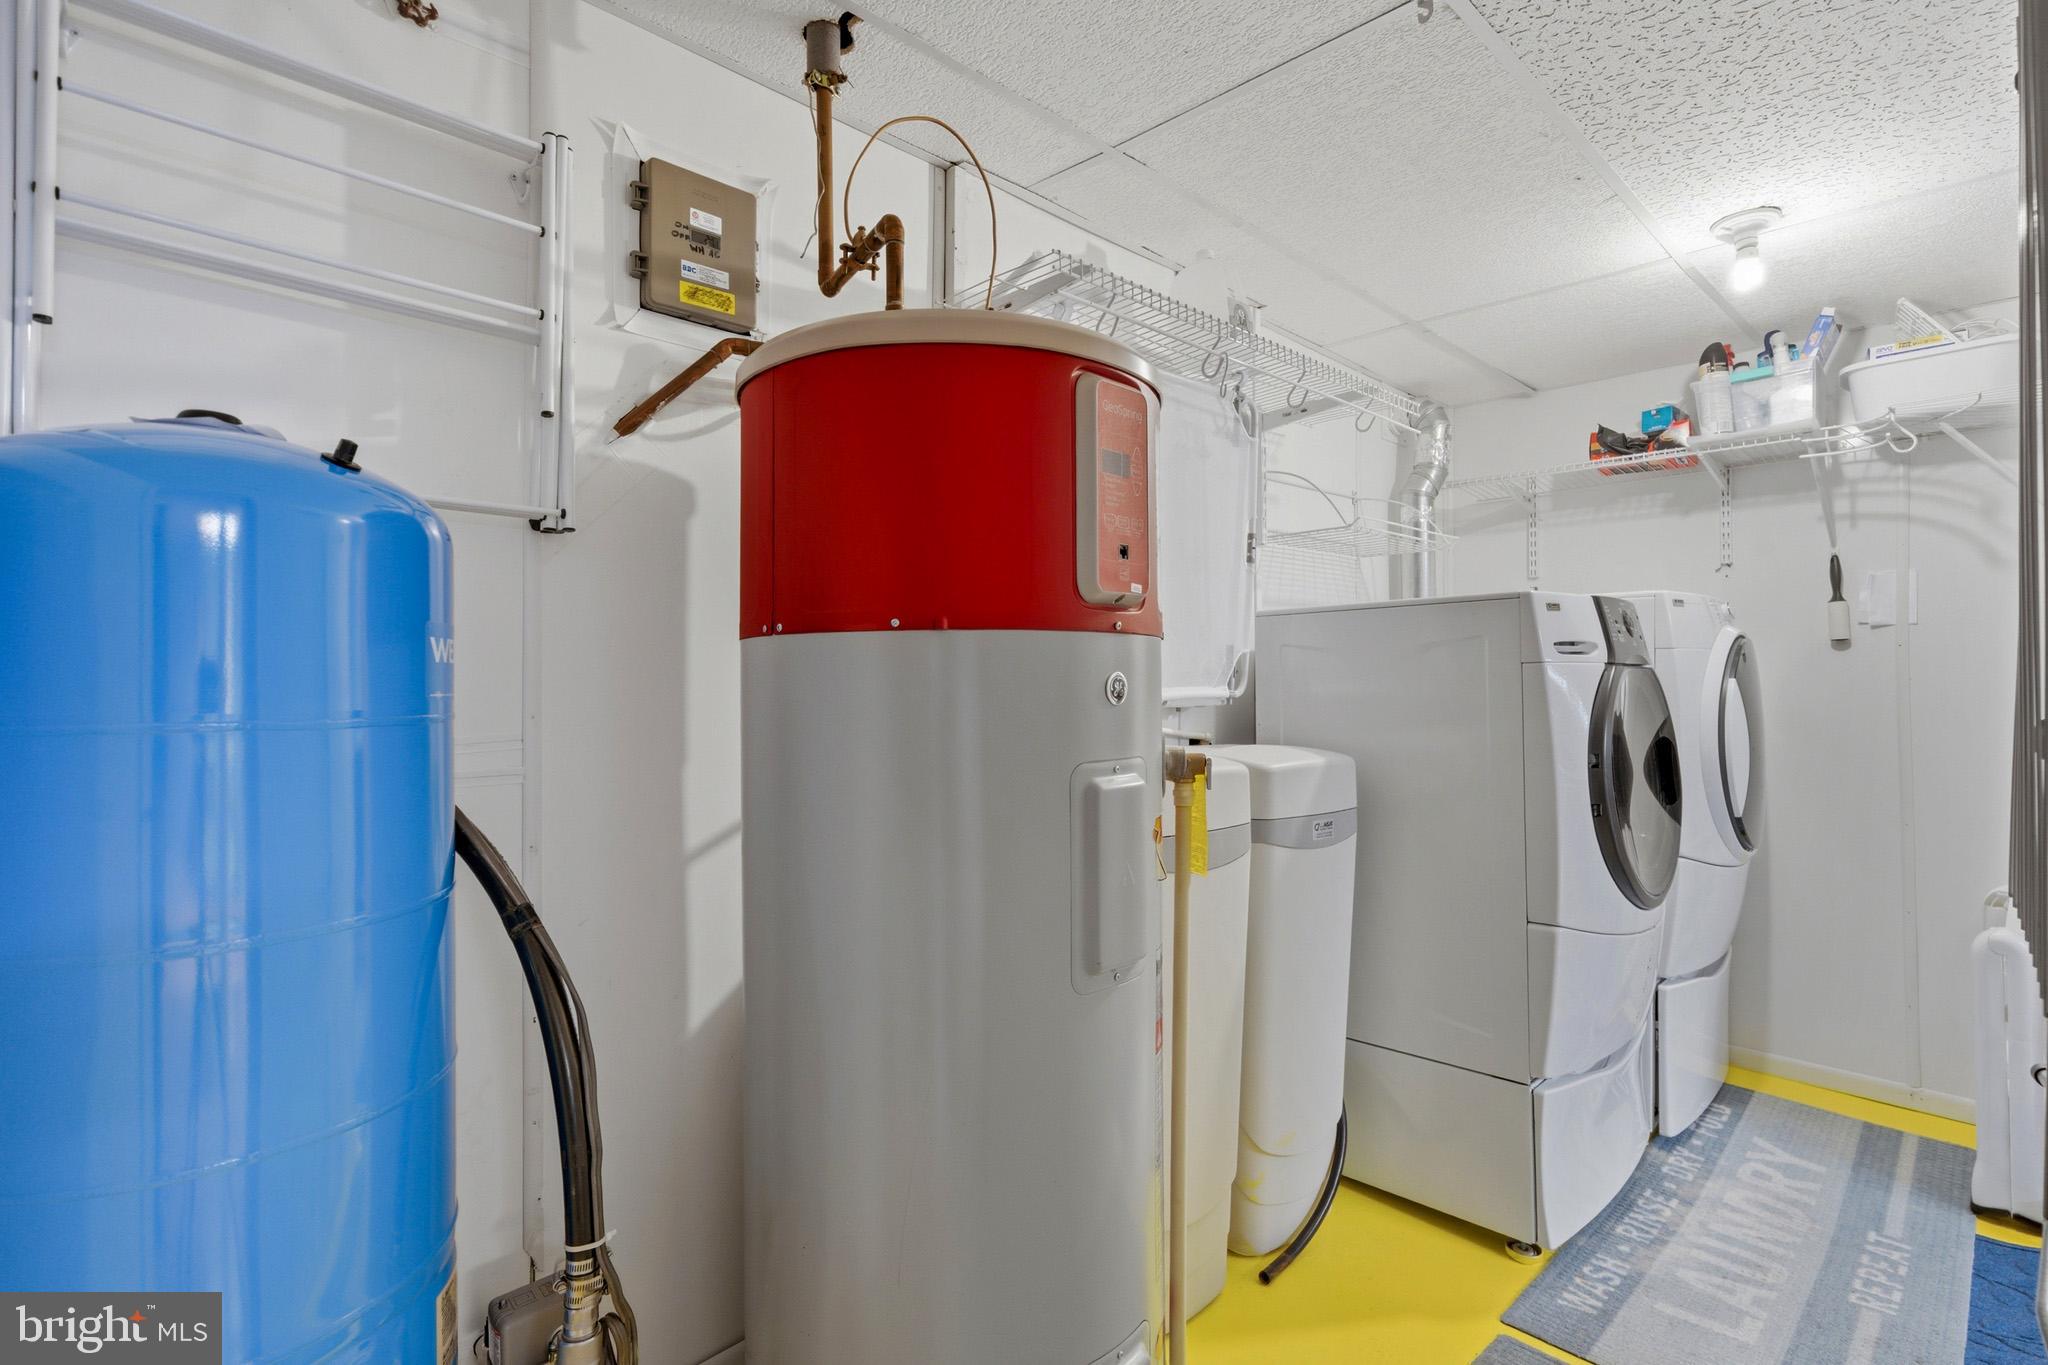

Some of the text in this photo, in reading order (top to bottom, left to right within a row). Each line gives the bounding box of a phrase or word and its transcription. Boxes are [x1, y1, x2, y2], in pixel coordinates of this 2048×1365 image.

[1557, 1252, 1632, 1314] WASH
[1615, 1188, 1680, 1245] RINSE
[1661, 1146, 1705, 1182] DRY
[1656, 1137, 1828, 1345] LAUNDRY
[1849, 1231, 1914, 1316] REPEAT
